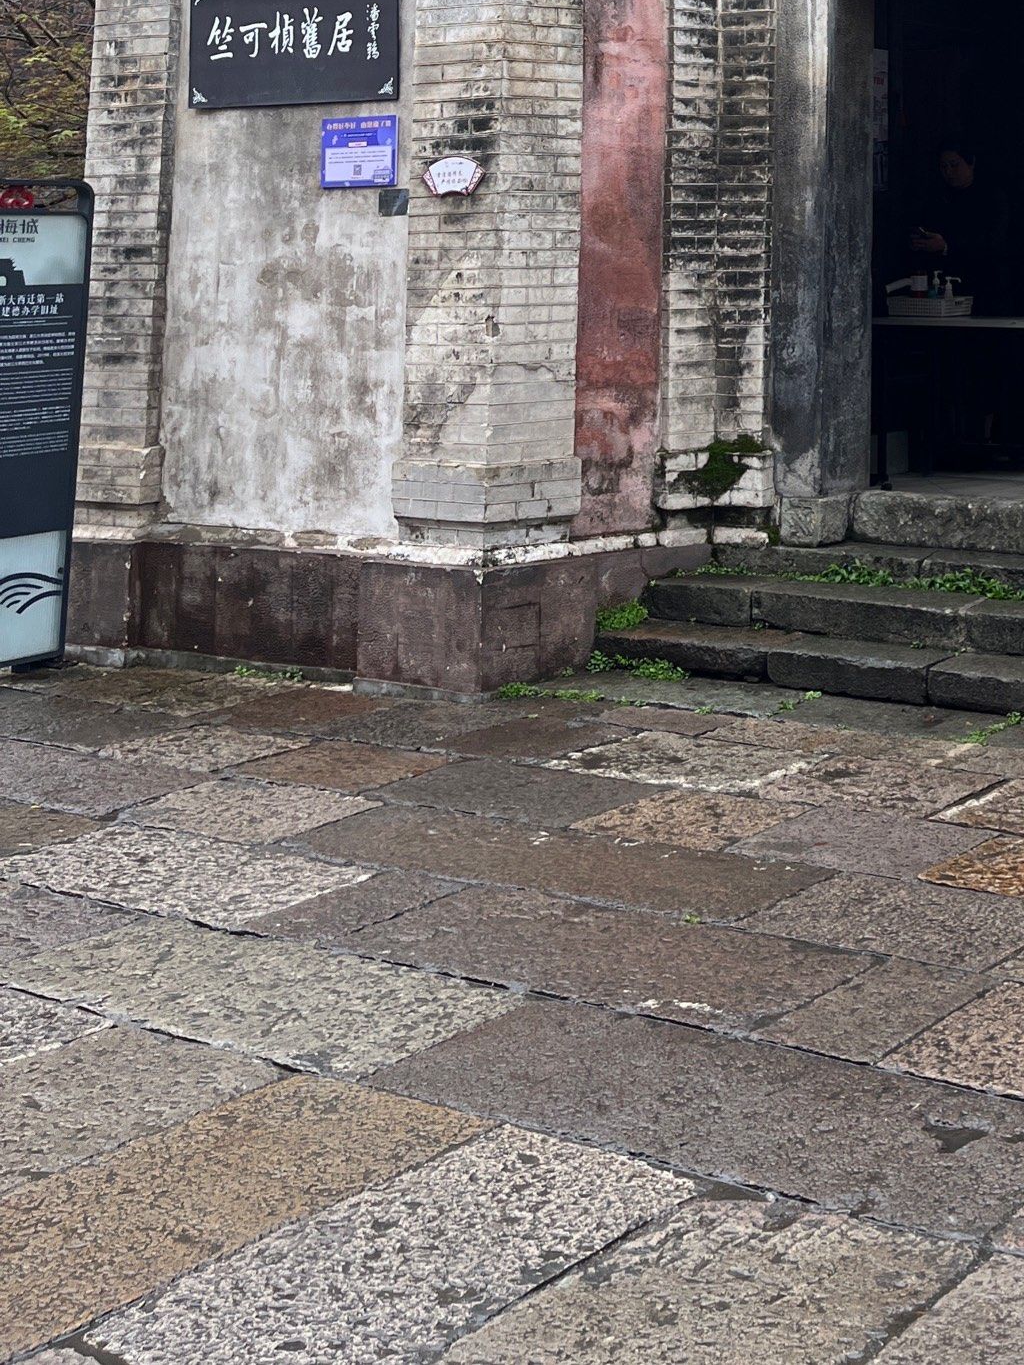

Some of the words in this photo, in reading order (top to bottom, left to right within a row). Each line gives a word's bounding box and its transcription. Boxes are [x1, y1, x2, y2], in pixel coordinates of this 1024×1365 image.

[1, 304, 59, 317] 建德办学旧址
